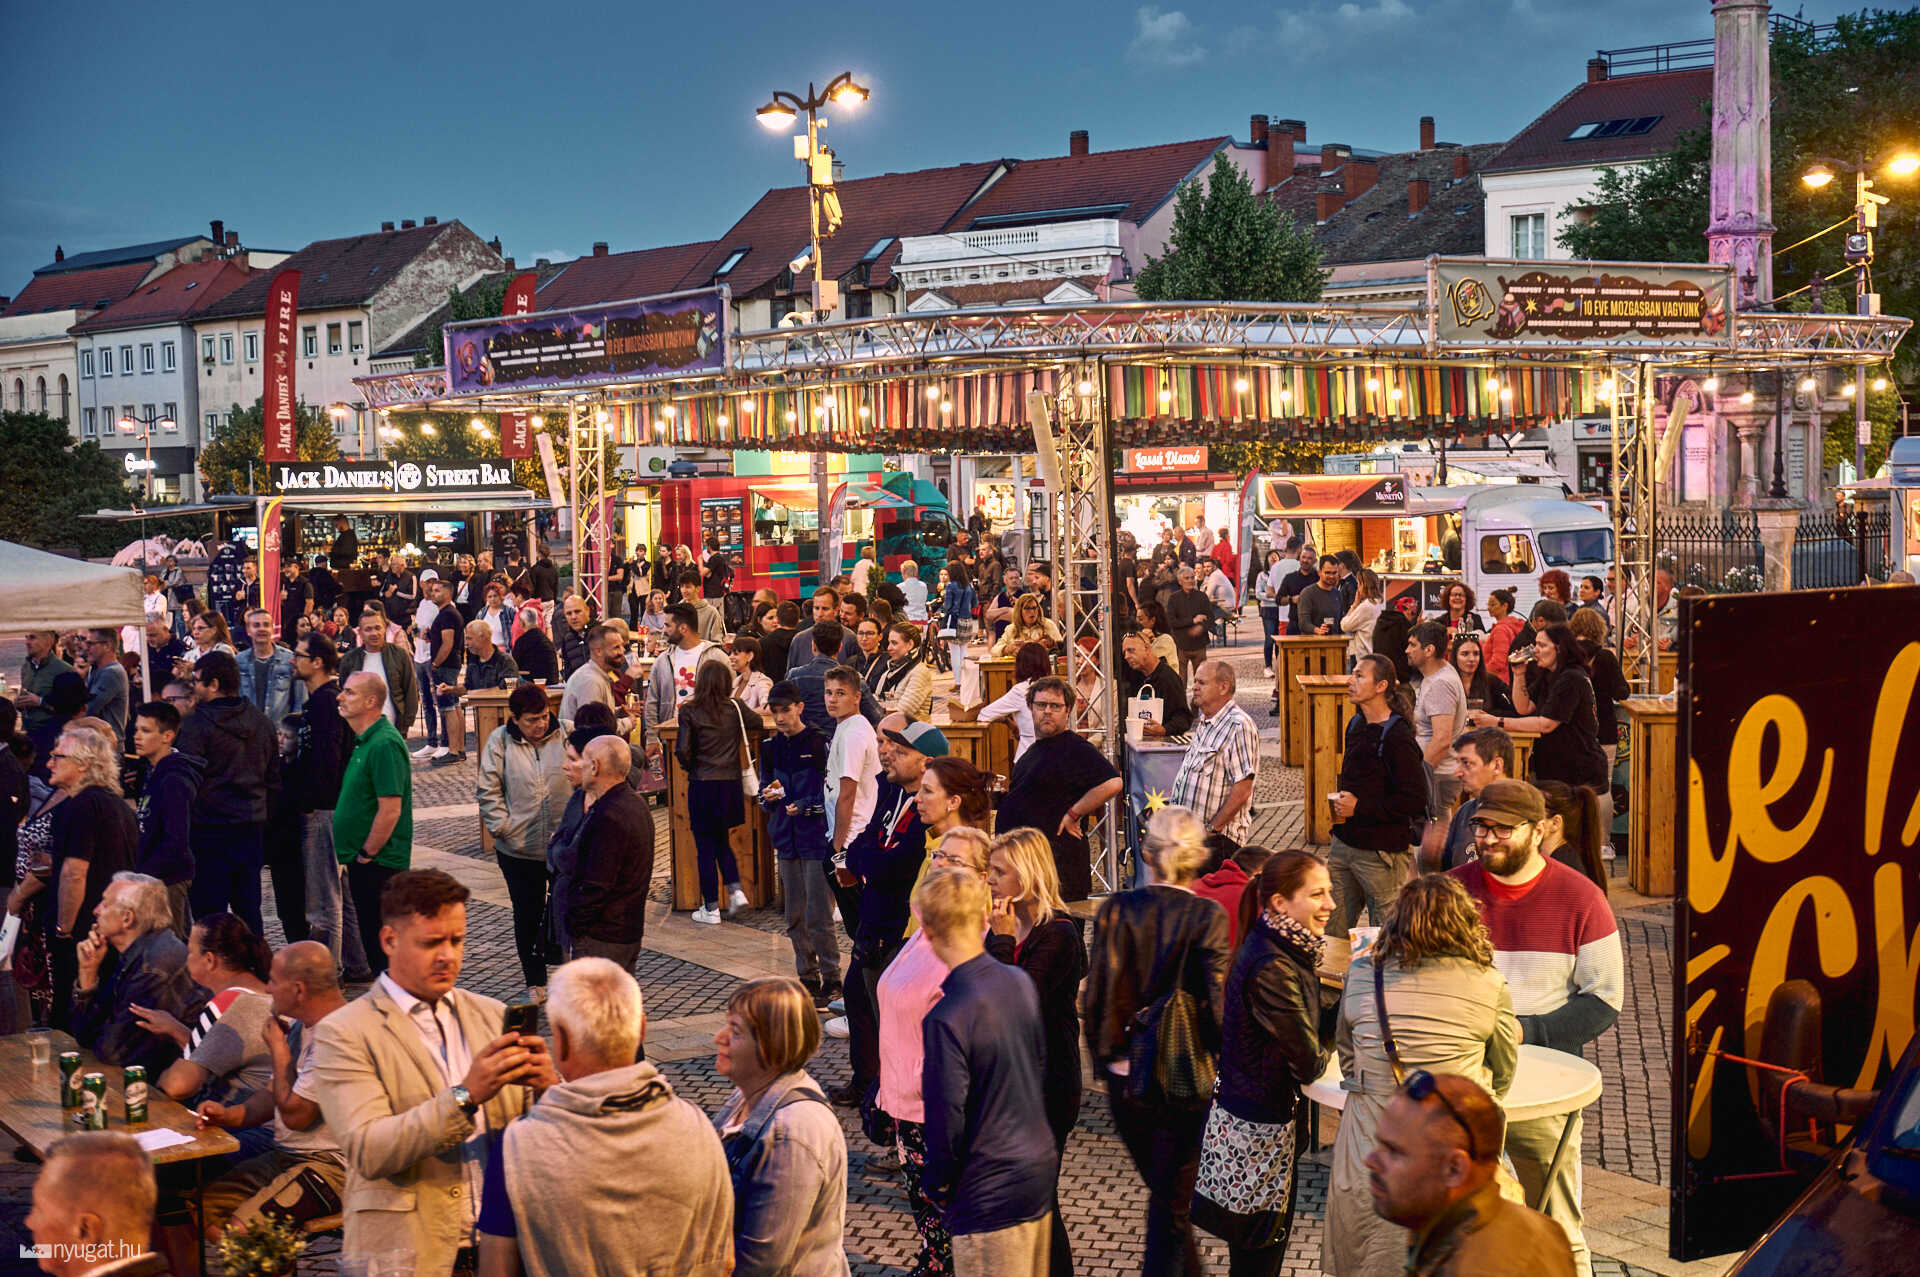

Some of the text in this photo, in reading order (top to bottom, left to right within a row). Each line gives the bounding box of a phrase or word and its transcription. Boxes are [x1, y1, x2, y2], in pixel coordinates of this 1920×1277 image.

[278, 290, 292, 345] FIRE
[1583, 299, 1593, 316] 10
[1662, 300, 1700, 318] VAGYUNK
[277, 421, 292, 454] JACK
[512, 419, 527, 449] JACK
[275, 466, 321, 490] JACK
[323, 464, 394, 489] DANIEL'S
[425, 463, 480, 487] STREET
[480, 463, 512, 485] BAR
